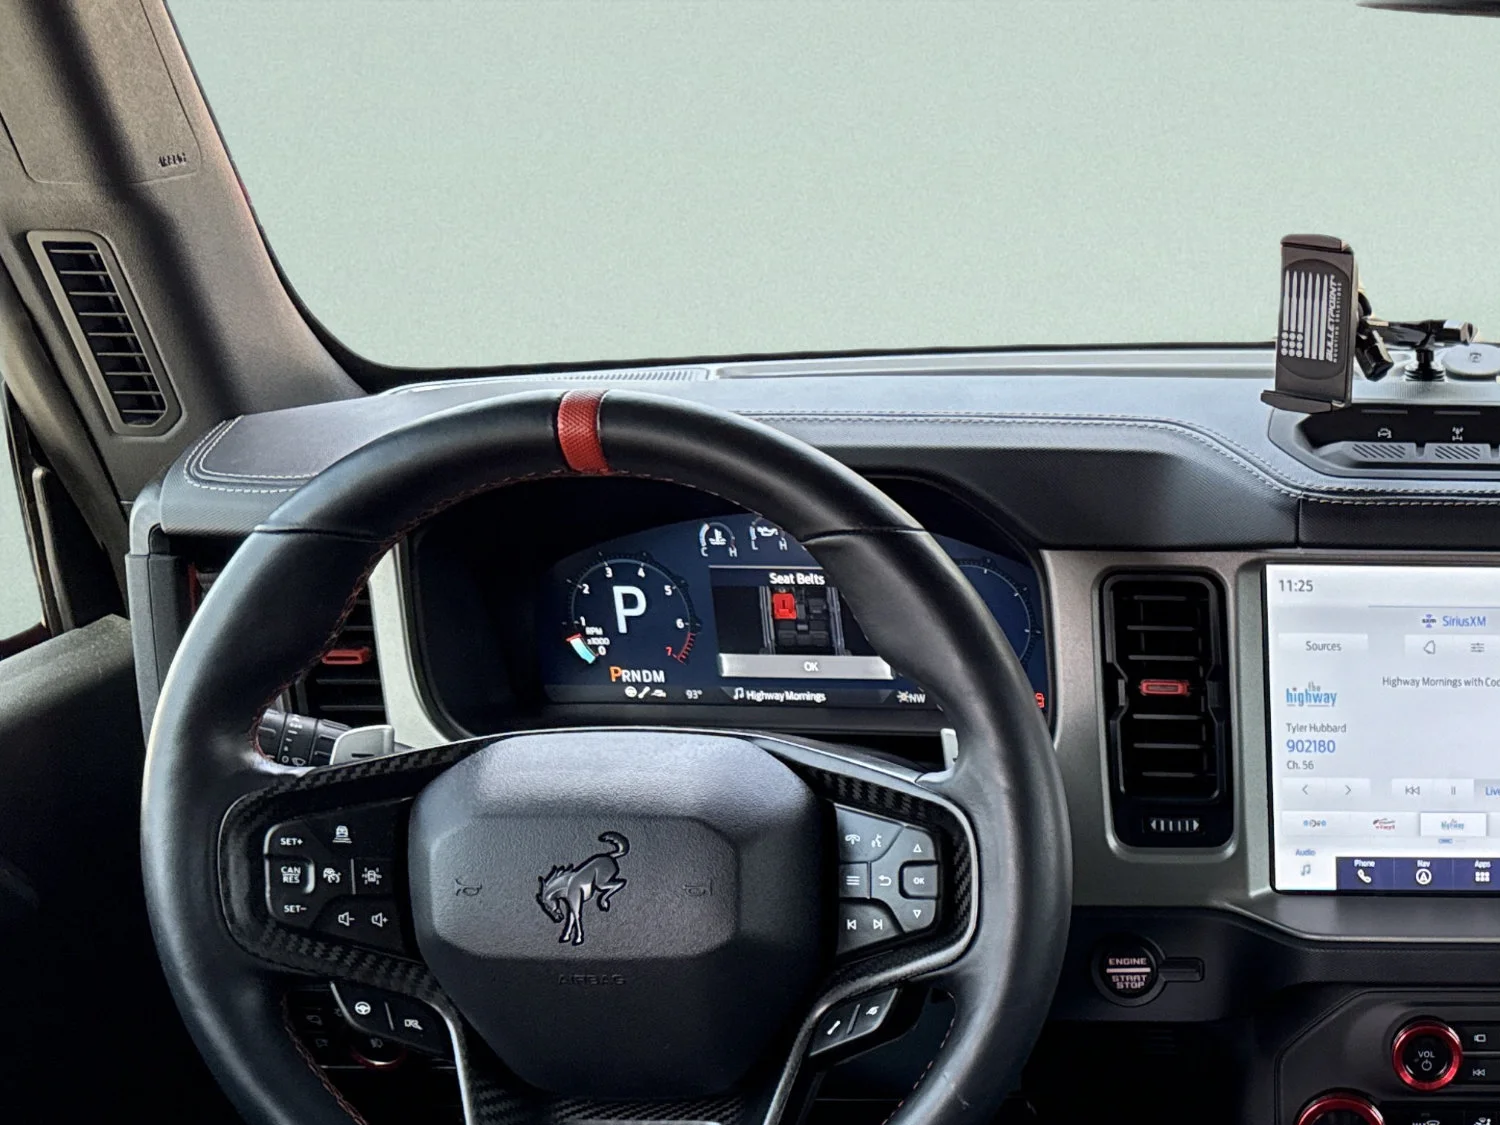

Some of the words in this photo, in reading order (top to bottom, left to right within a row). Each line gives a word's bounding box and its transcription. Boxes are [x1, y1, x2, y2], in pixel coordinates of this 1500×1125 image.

[605, 568, 613, 578] 3
[638, 567, 646, 578] 4
[769, 572, 795, 585] Seat
[796, 572, 826, 586] Belts
[582, 584, 590, 594] 2
[664, 585, 673, 596] 5
[1278, 579, 1314, 593] 11:25
[612, 585, 647, 634] P
[676, 618, 685, 629] 6
[1442, 615, 1487, 627] SiriusXM
[1305, 640, 1342, 651] Sources
[803, 661, 819, 672] OK
[1382, 676, 1420, 688] Highway
[1422, 676, 1463, 689] Mornings
[1464, 677, 1484, 687] with
[746, 690, 785, 702] Highway
[785, 691, 827, 703] Mornings
[909, 693, 926, 704] NW
[1285, 686, 1337, 708] highway
[1286, 722, 1308, 734] Tyler
[1309, 723, 1347, 733] Hubbard
[1286, 739, 1336, 754] 902180
[1286, 760, 1301, 770] Ch.
[1302, 760, 1315, 770] 56
[1295, 849, 1316, 857] Audio
[1353, 859, 1376, 868] Phone
[1416, 859, 1431, 868] Nav
[1474, 860, 1491, 869] Apps
[280, 866, 301, 875] CAN
[282, 875, 301, 884] RES
[913, 877, 925, 885] OK
[1108, 957, 1147, 966] ENGINE
[1116, 982, 1145, 990] STOP
[1418, 1050, 1436, 1059] VOL
